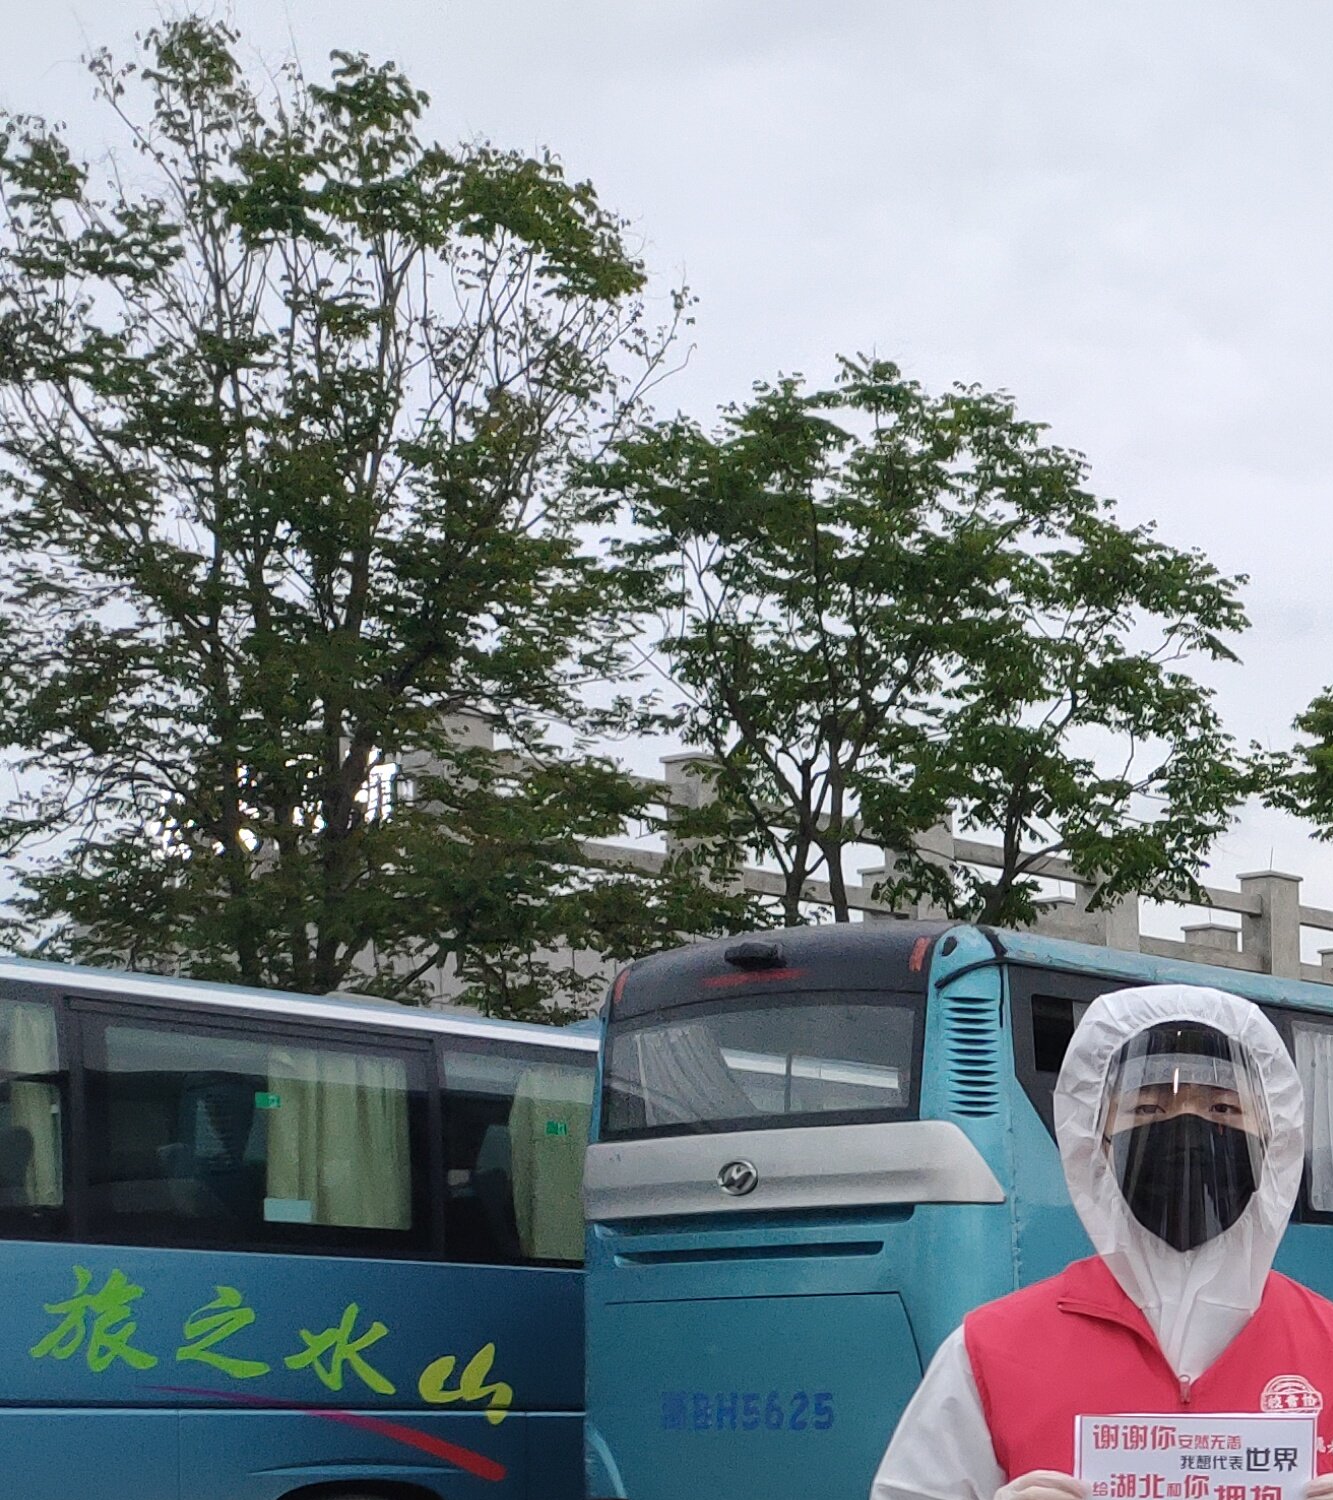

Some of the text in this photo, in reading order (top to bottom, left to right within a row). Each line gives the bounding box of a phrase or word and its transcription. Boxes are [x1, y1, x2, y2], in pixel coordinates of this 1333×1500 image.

[1092, 1424, 1242, 1451] 谢谢你安然无恙
[1180, 1447, 1298, 1472] 我想代表世界
[1092, 1473, 1210, 1499] 给湖北和你
